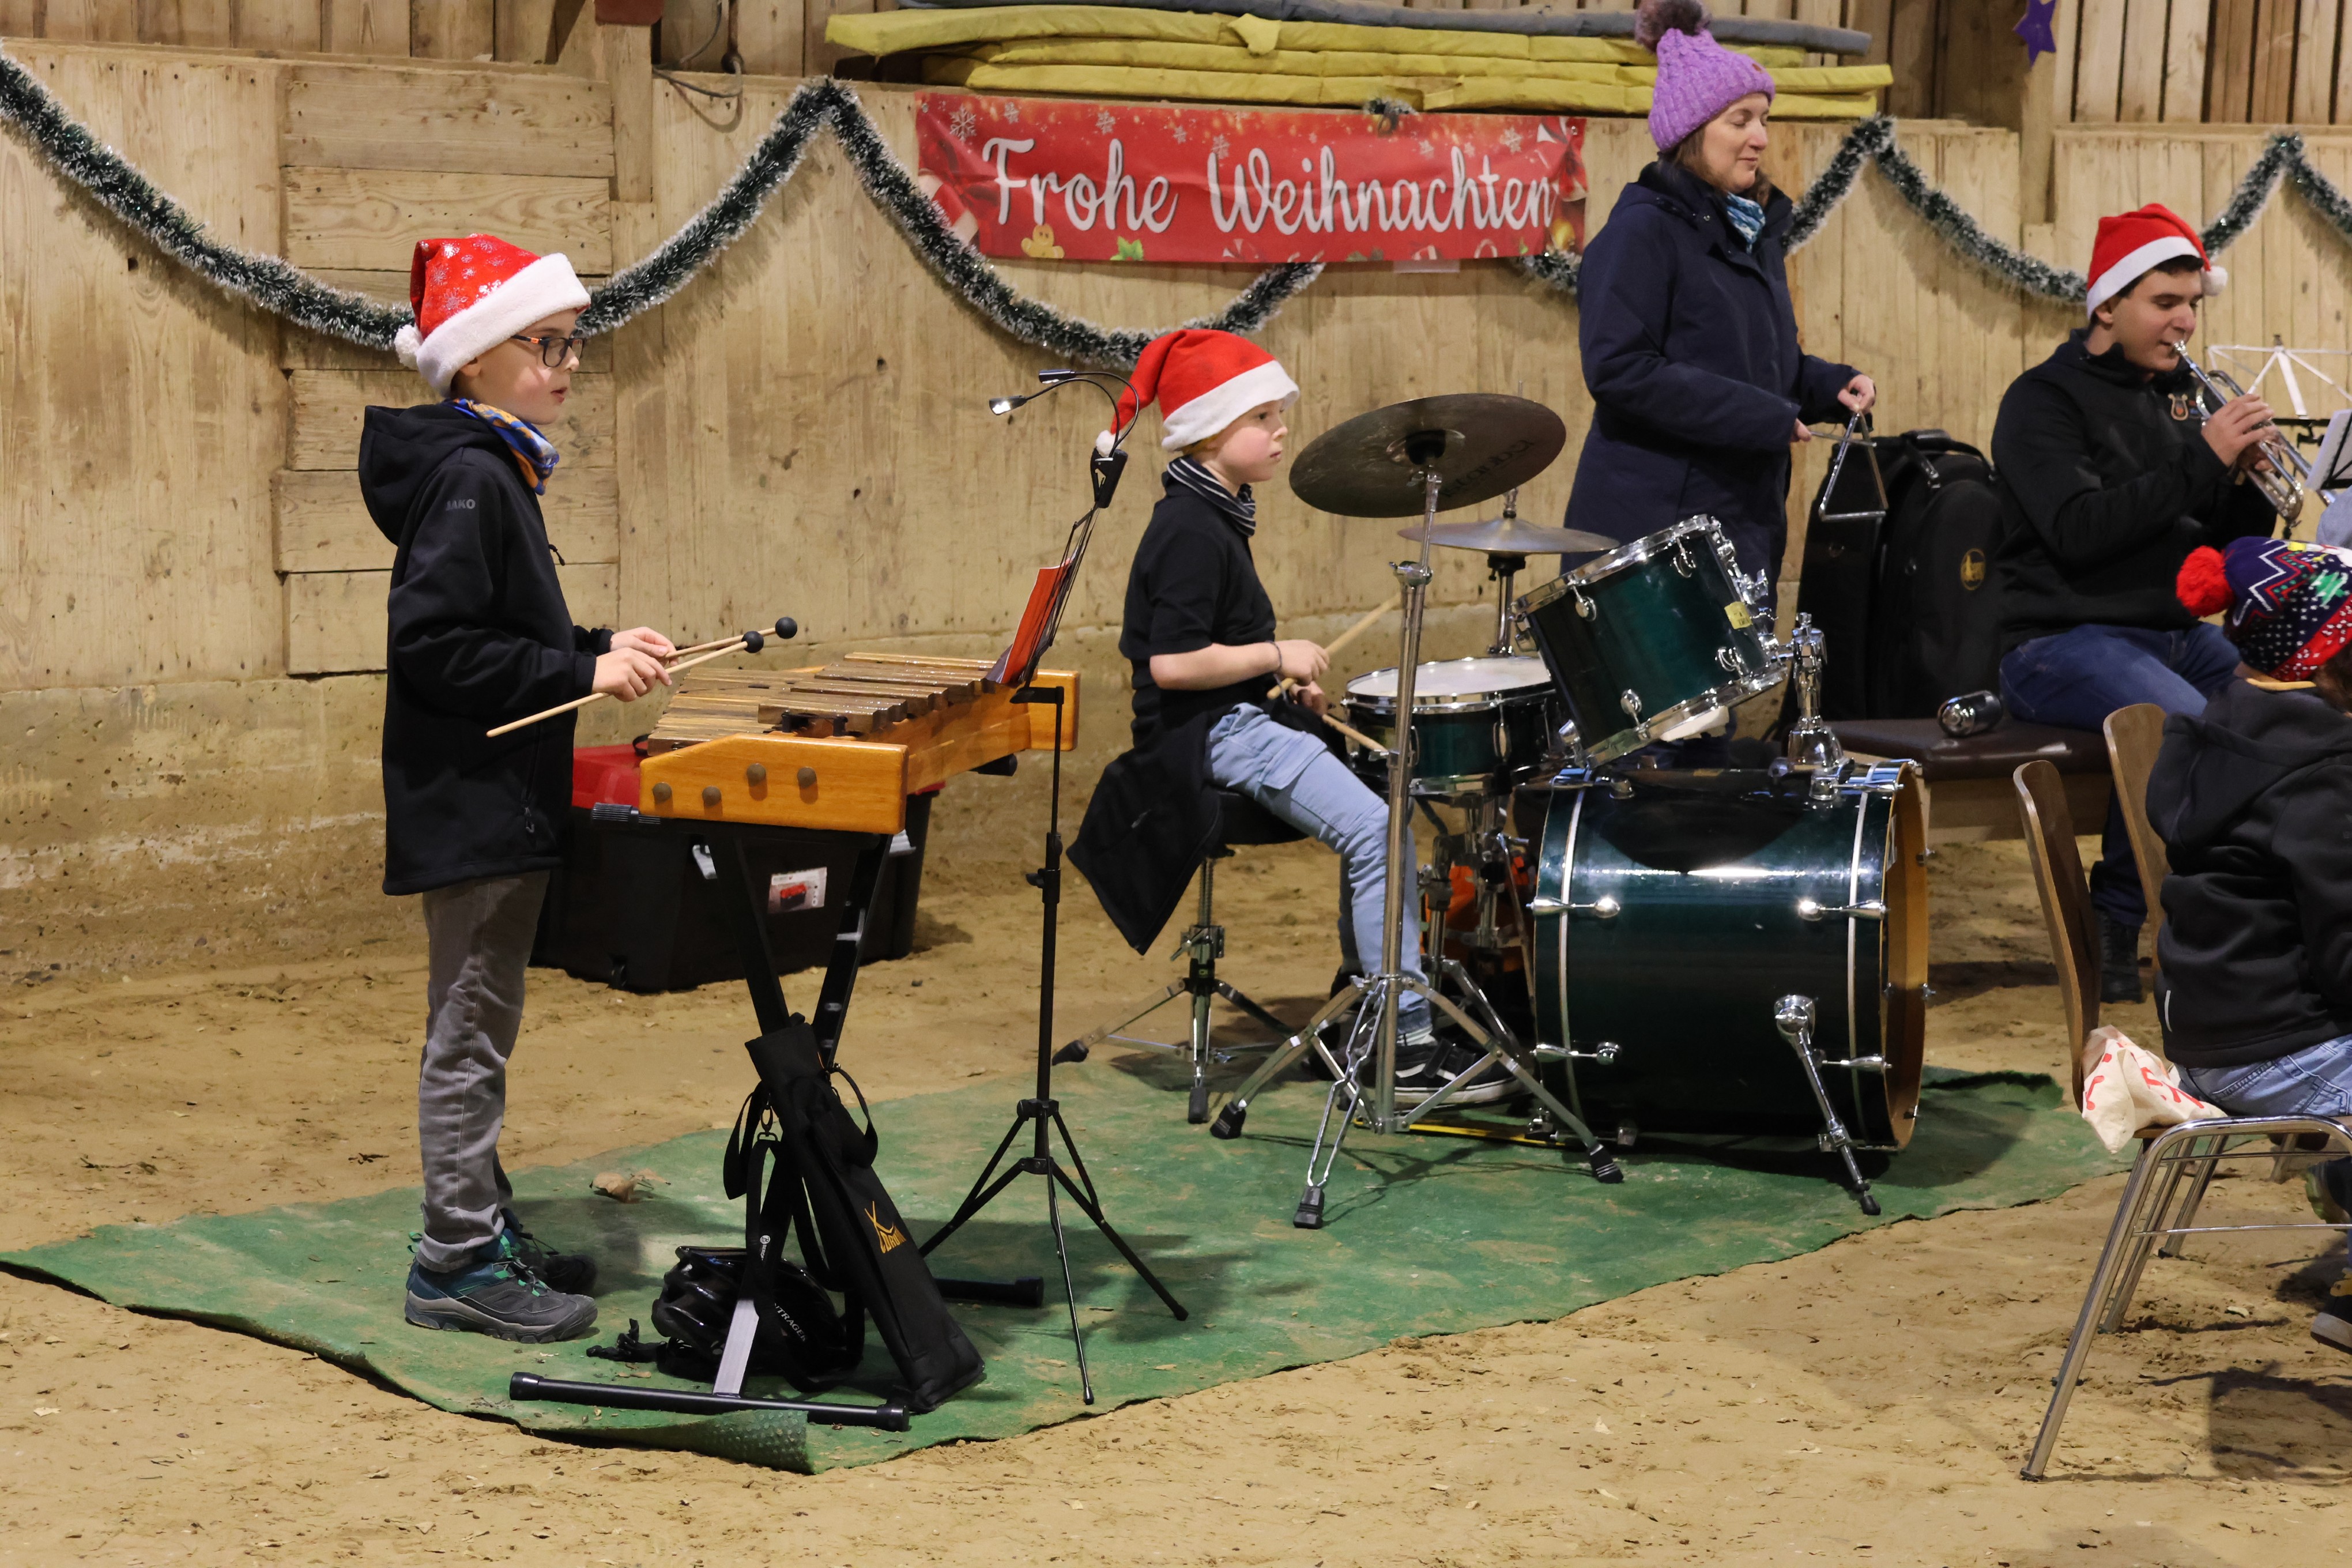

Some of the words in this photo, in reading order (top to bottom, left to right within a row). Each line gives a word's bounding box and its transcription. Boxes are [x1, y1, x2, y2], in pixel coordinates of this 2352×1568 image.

[982, 138, 1177, 233] Frohe
[1207, 145, 1558, 234] Weihnachten
[446, 499, 476, 511] JAKO
